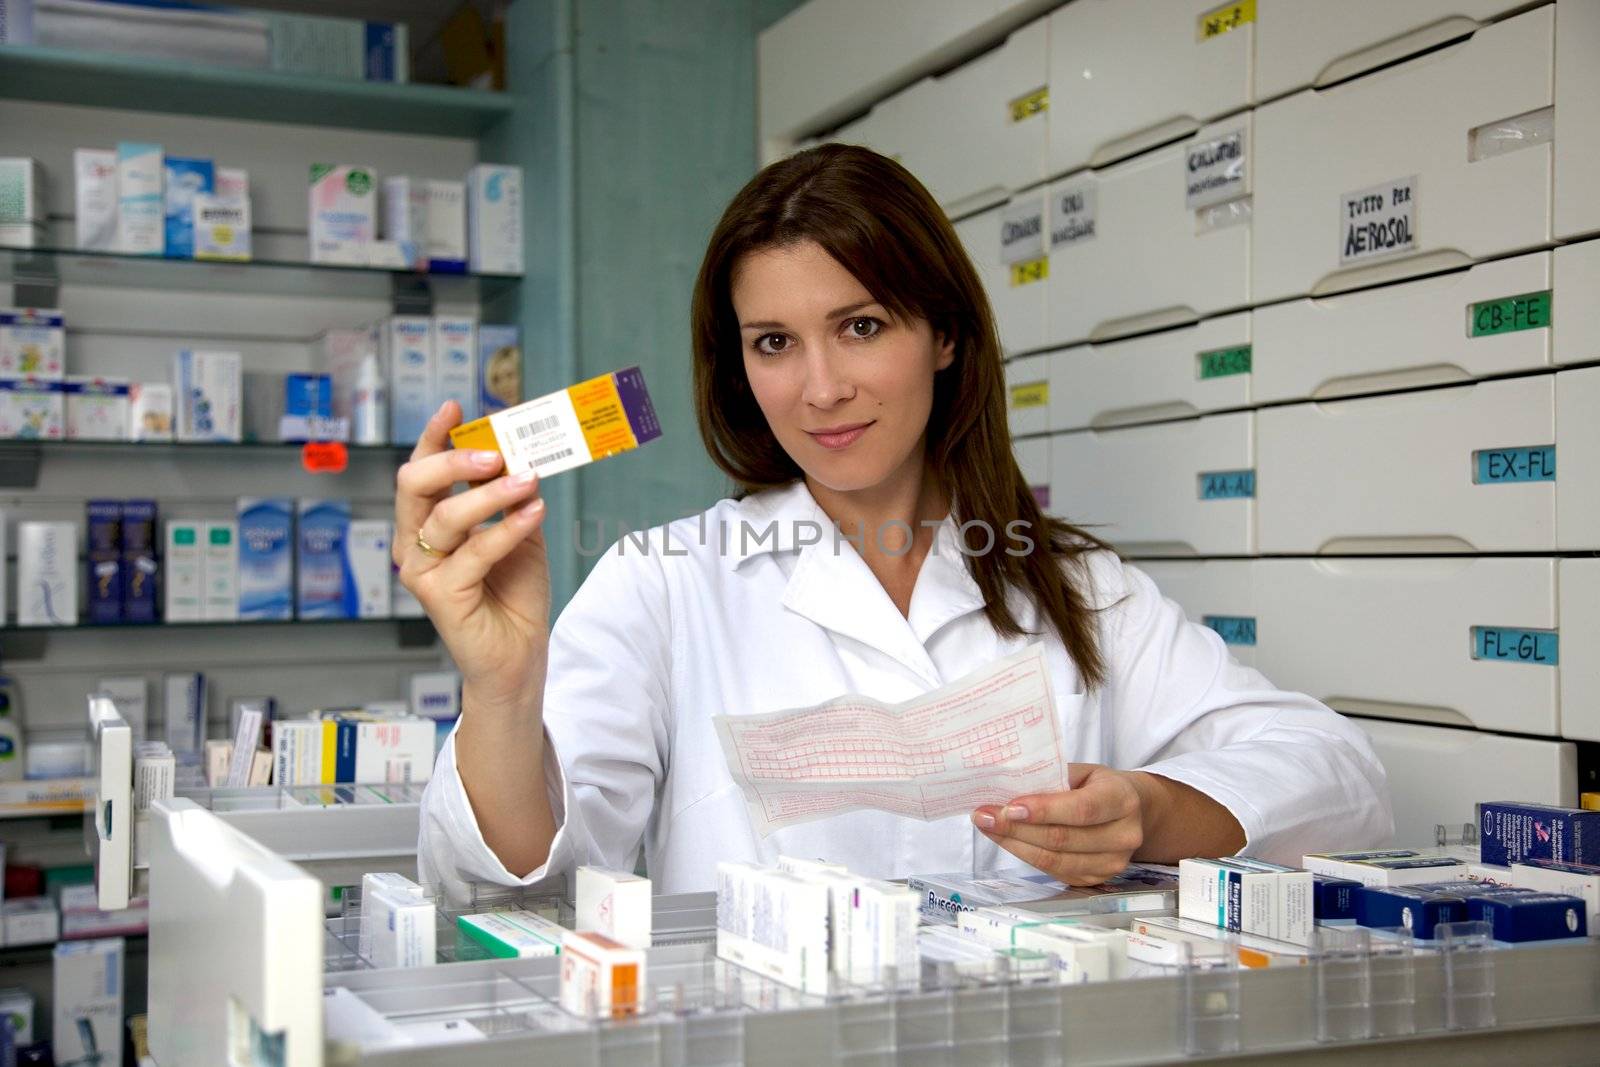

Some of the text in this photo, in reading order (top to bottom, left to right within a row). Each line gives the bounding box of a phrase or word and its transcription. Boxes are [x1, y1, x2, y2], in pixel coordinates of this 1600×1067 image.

[1348, 194, 1383, 218] TUTTO
[1344, 214, 1413, 256] AEROSOL
[1475, 298, 1541, 332] CB-FE
[1488, 451, 1553, 478] EX-FL
[1483, 630, 1545, 661] FL-GL
[1557, 819, 1564, 830] 30
[1232, 882, 1241, 924] Respicur
